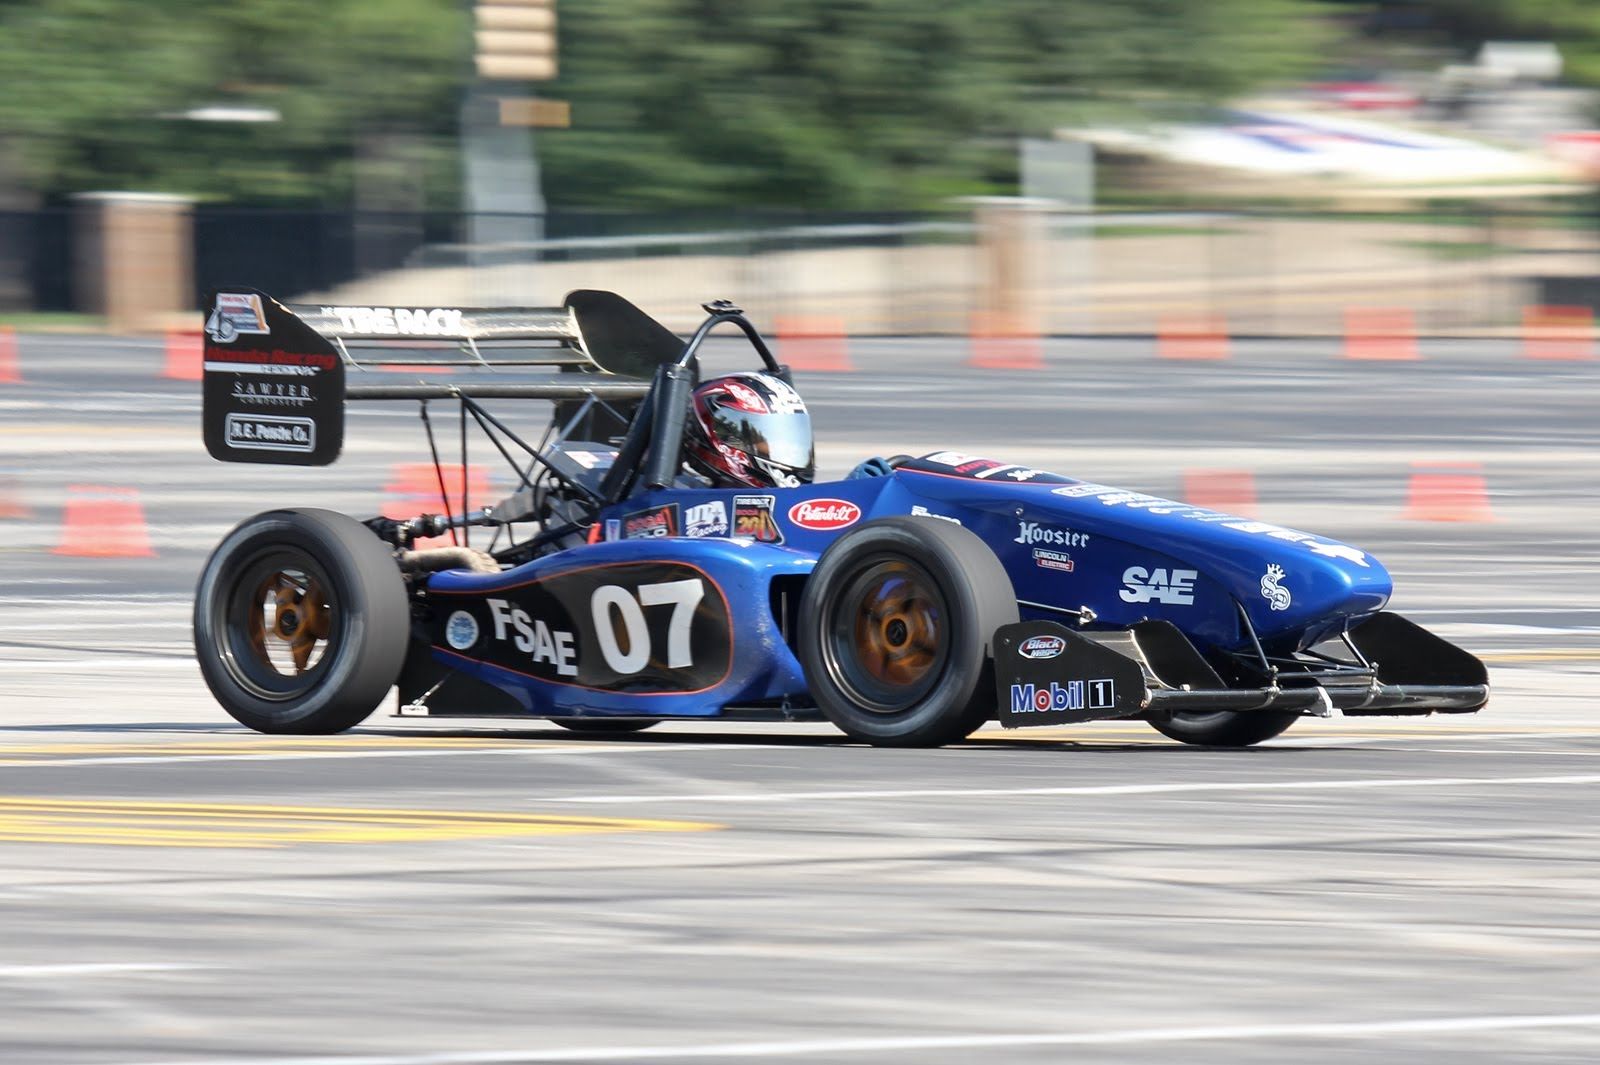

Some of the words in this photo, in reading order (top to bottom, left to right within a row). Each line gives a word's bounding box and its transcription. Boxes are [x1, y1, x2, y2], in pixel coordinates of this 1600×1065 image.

[334, 307, 398, 334] TIRE
[395, 308, 469, 337] RACK
[233, 381, 311, 397] SAWYER
[684, 500, 729, 527] UTA
[797, 503, 857, 522] Peterbilt
[685, 523, 729, 538] Racing
[1014, 521, 1090, 548] Hoosier
[1034, 550, 1068, 562] LINCOLN
[1040, 559, 1071, 570] ELECTRIC
[1118, 566, 1198, 606] SAE
[486, 598, 579, 677] FSAE
[591, 578, 705, 675] 07
[1026, 639, 1060, 650] Black
[1010, 680, 1085, 713] Mobil
